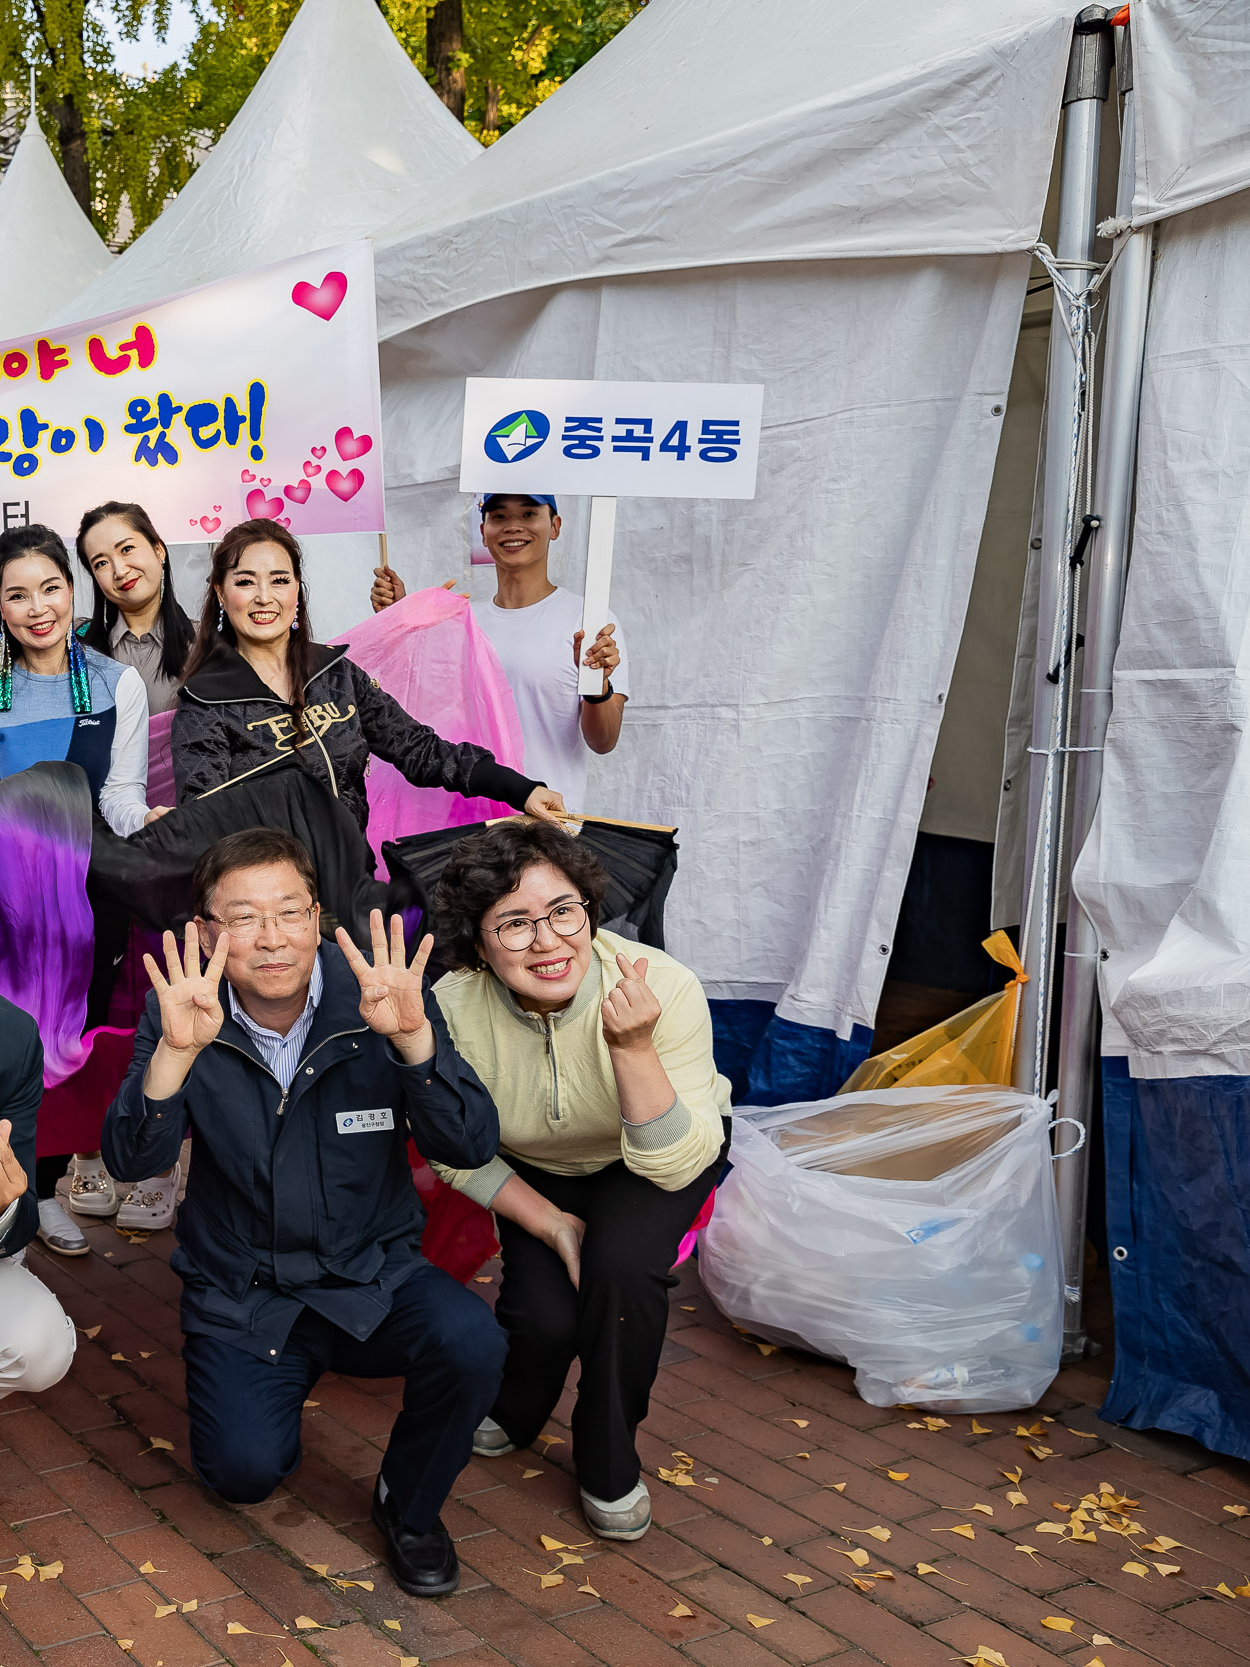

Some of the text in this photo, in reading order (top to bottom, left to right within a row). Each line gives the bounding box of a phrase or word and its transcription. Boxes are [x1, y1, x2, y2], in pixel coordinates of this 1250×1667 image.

[86, 322, 159, 378] 너
[121, 378, 270, 469] 왔다!
[560, 416, 742, 463] 중곡4동
